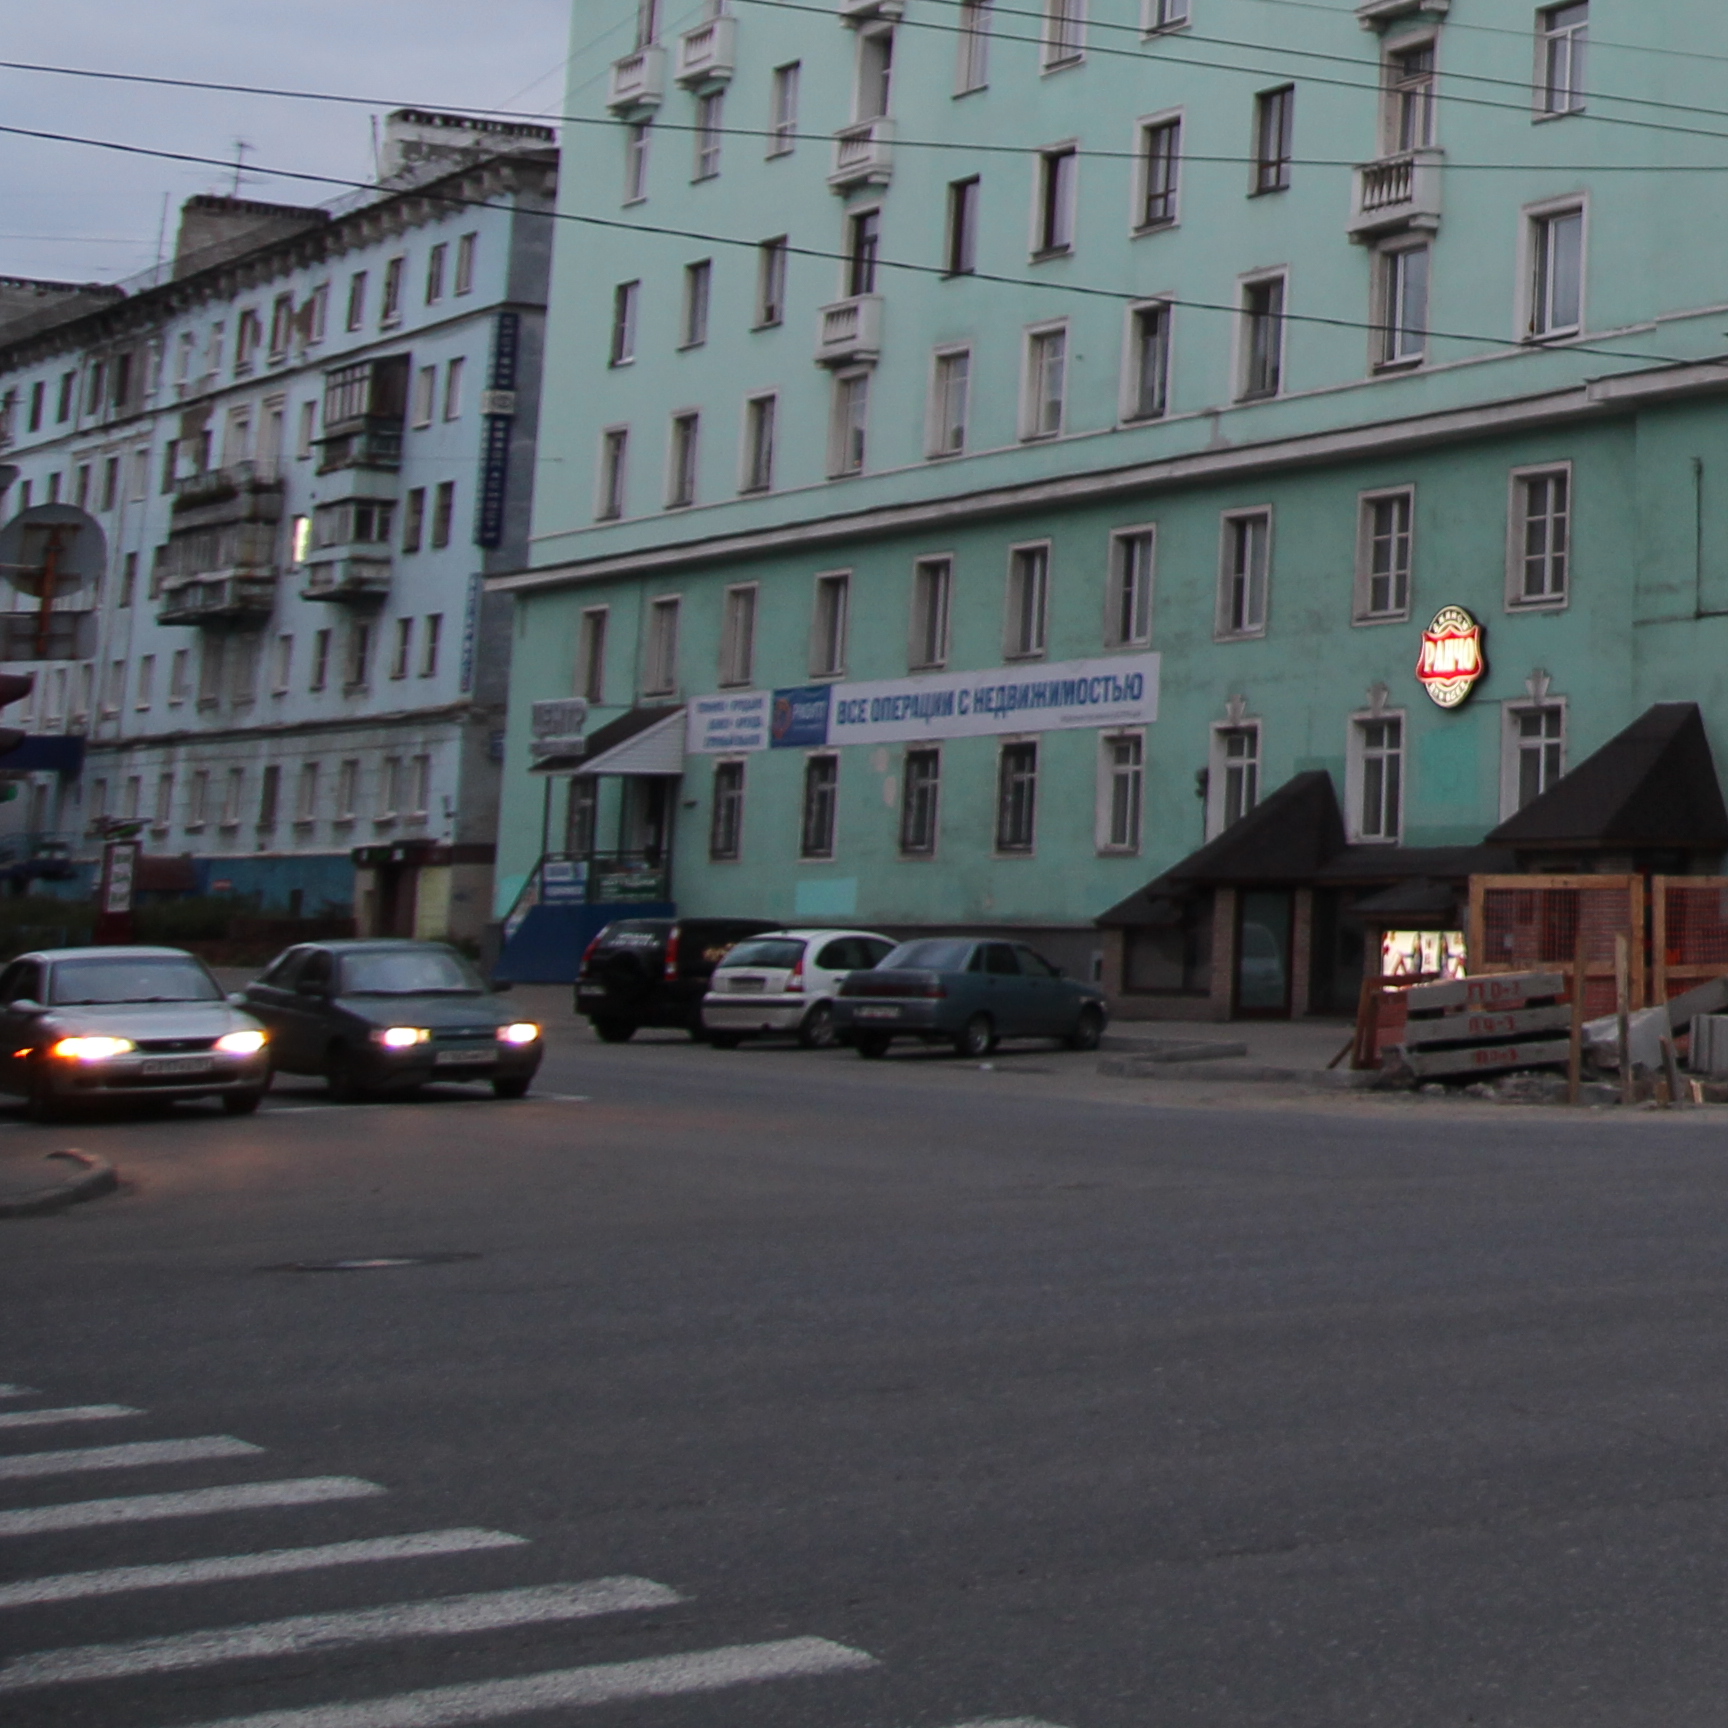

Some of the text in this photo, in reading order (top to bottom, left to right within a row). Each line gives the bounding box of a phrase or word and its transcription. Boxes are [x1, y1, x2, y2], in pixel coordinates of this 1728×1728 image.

[1424, 637, 1477, 673] РАНЧО
[836, 671, 1144, 725] ВСЕ ОПЕРАЦИИ С НЕДВИЖИМОСТЬЮ
